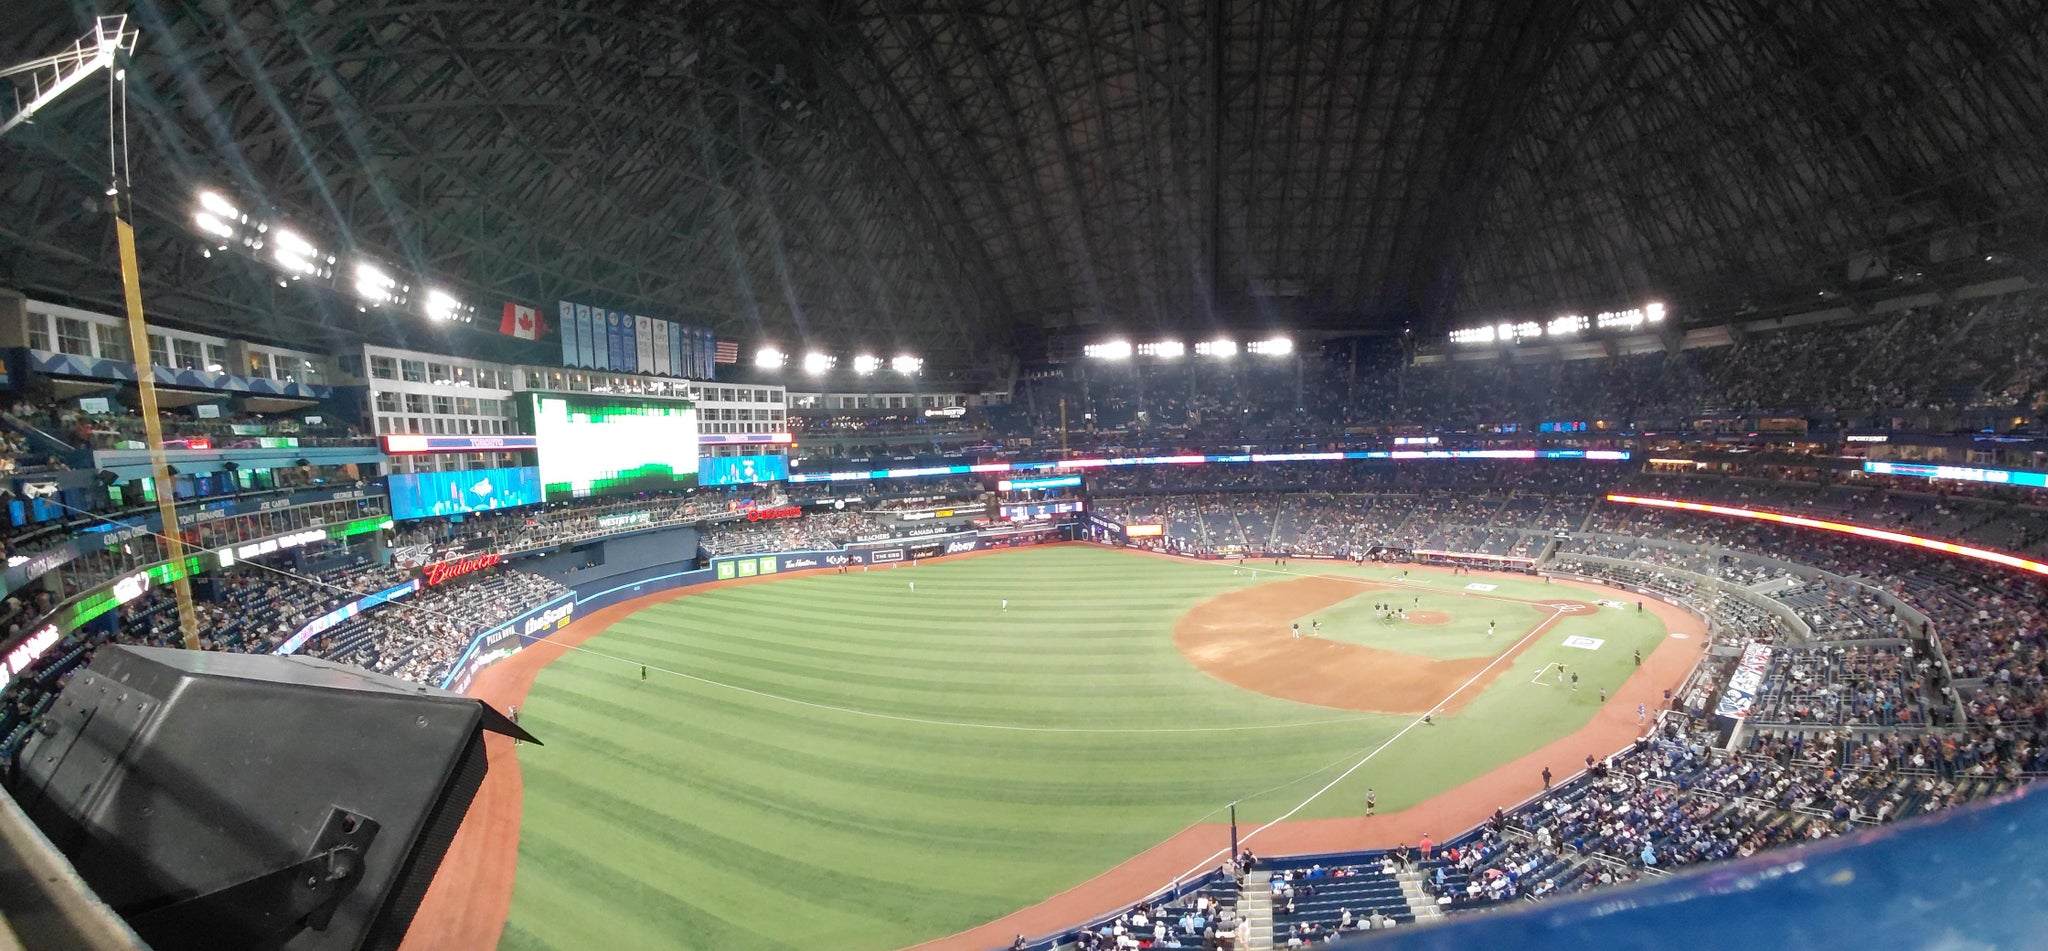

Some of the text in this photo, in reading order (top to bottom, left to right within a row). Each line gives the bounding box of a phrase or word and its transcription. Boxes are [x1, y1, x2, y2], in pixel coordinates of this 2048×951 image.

[470, 438, 504, 447] TORONTO
[260, 498, 290, 510] JOE CARTER
[179, 509, 225, 525] TONY FERNANDEZ
[761, 506, 802, 519] ROGERS
[599, 515, 630, 528] WESTJET
[857, 533, 890, 542] BLEACHERS
[909, 527, 947, 537] CANADA DRY
[947, 541, 976, 554] Sobeys
[423, 552, 501, 587] Budweiser
[785, 559, 817, 569] Tim Hortons
[525, 602, 574, 636] theScore
[486, 633, 502, 647] PIZZA
